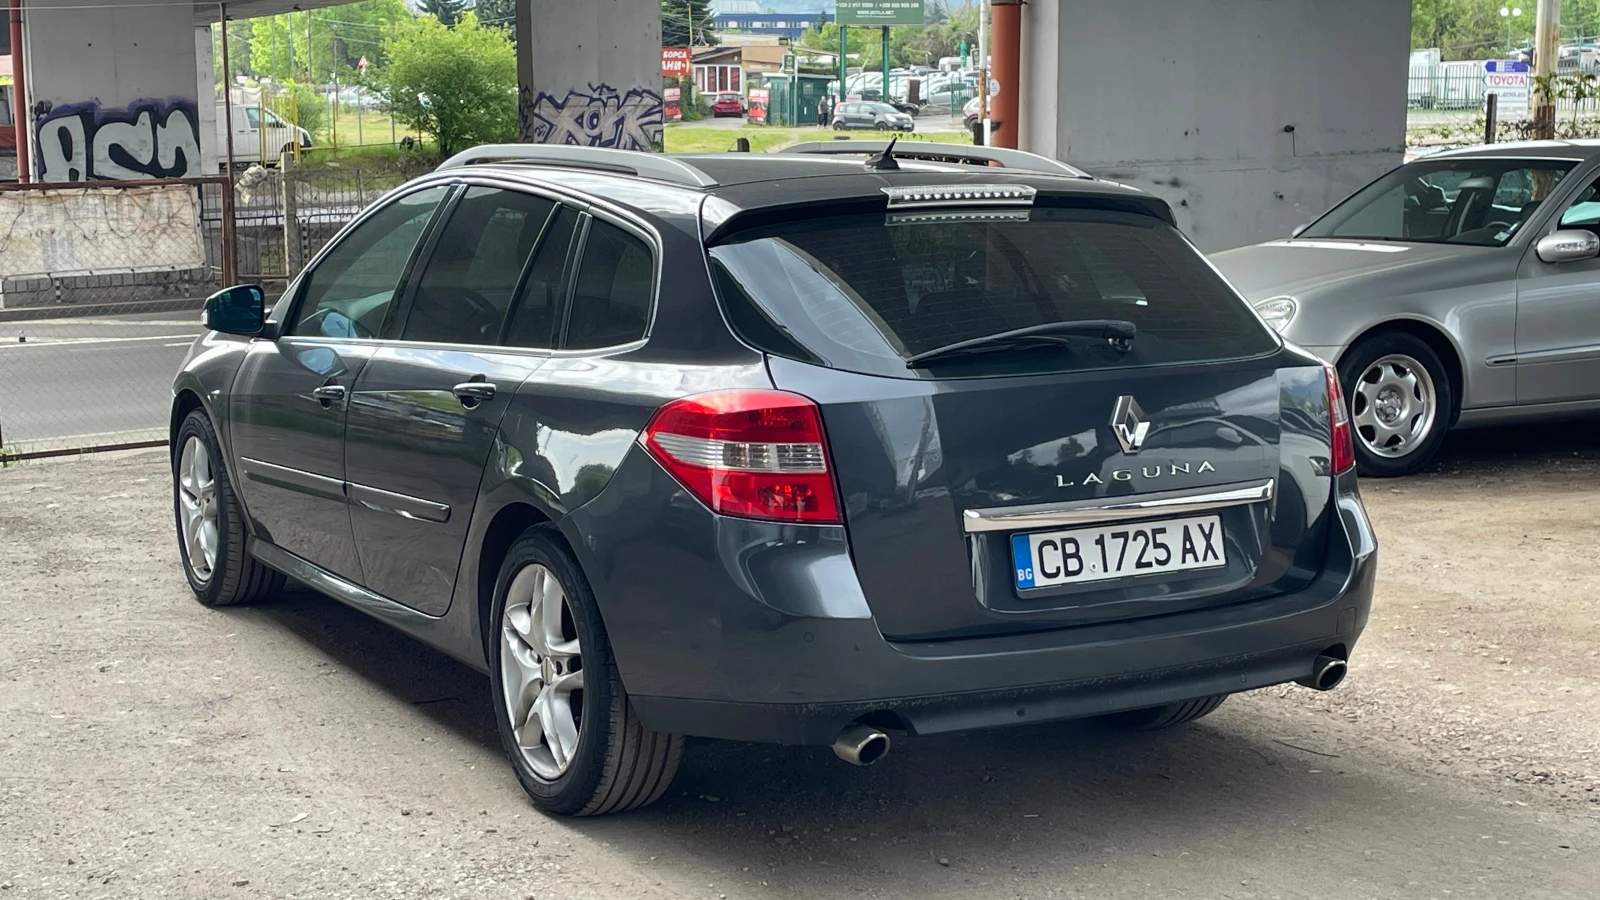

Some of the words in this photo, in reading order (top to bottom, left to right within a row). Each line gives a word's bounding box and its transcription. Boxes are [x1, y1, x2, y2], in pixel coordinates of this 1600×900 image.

[663, 51, 687, 59] БОРСА
[1489, 75, 1525, 86] TOYOTA
[1056, 460, 1216, 488] LAGUNA
[1037, 537, 1084, 579] CB
[1095, 527, 1172, 573] 1725
[1181, 522, 1220, 565] AX
[1017, 568, 1033, 581] BG
